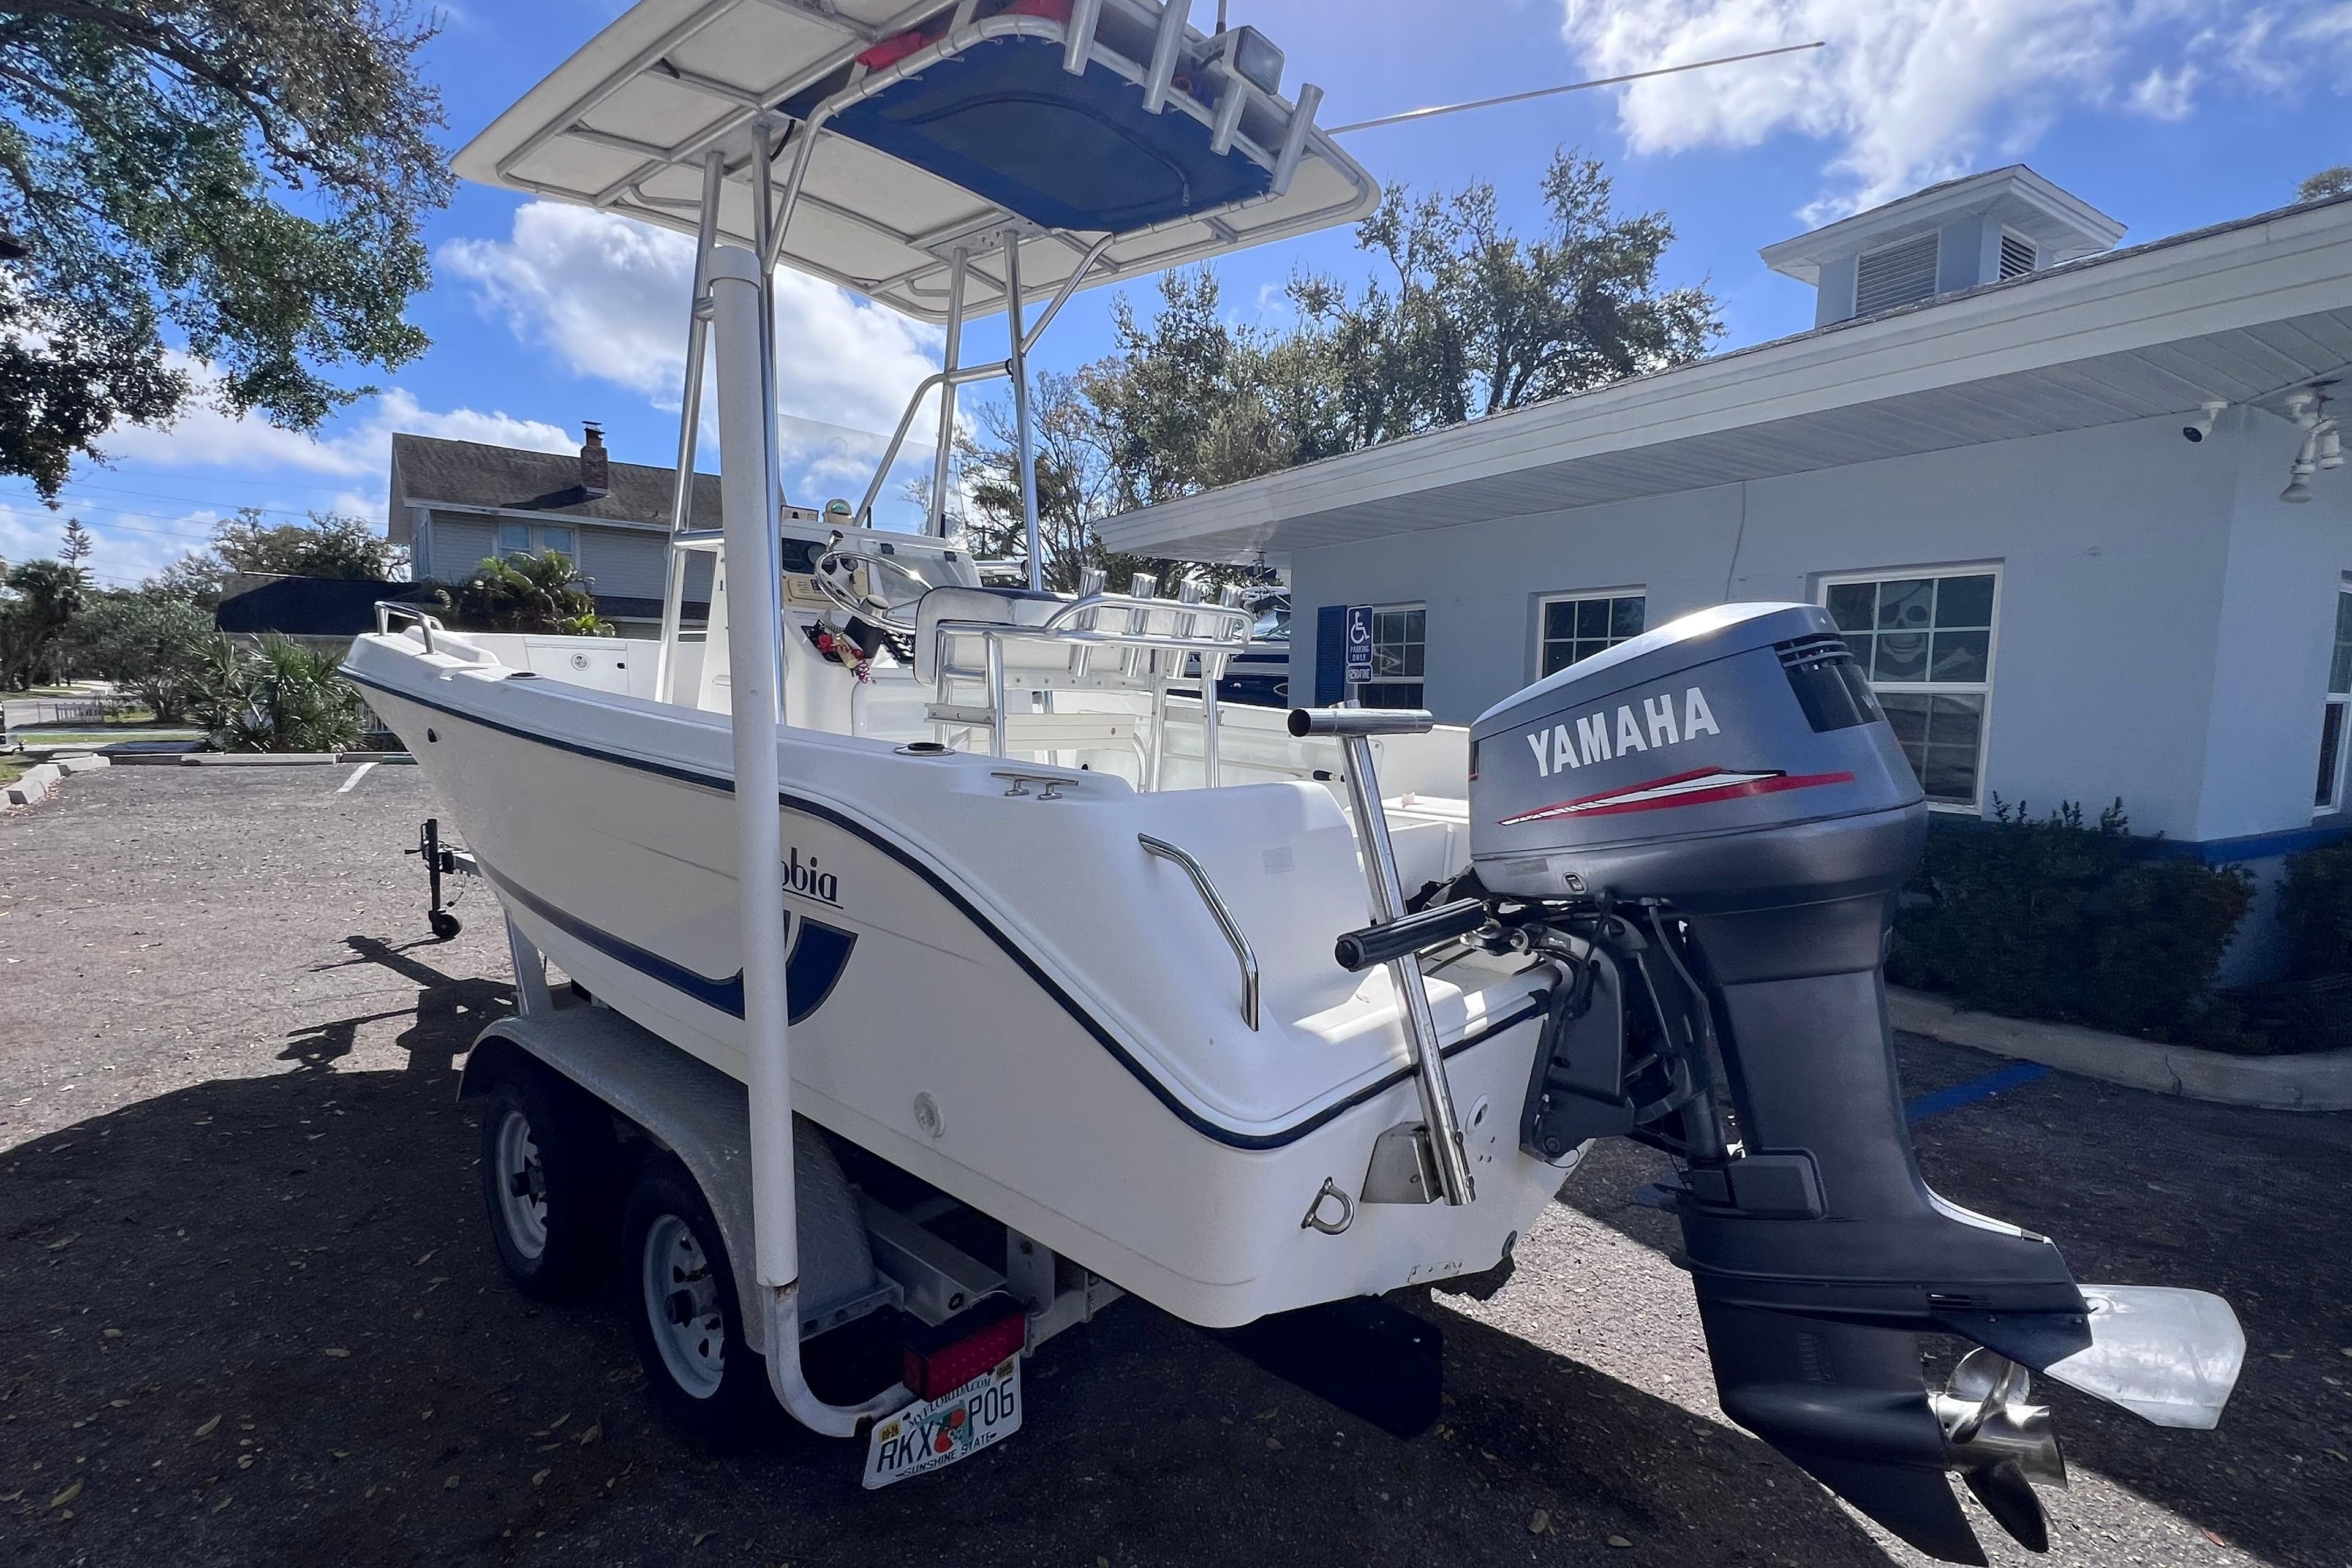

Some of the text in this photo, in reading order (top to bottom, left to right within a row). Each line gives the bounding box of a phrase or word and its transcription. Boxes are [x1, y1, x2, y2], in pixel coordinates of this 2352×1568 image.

[1350, 645, 1370, 654] PARKING
[1526, 687, 1721, 778] YAMAHA
[876, 1420, 934, 1473] RKX
[903, 1431, 992, 1476] SUNSHINE STATE
